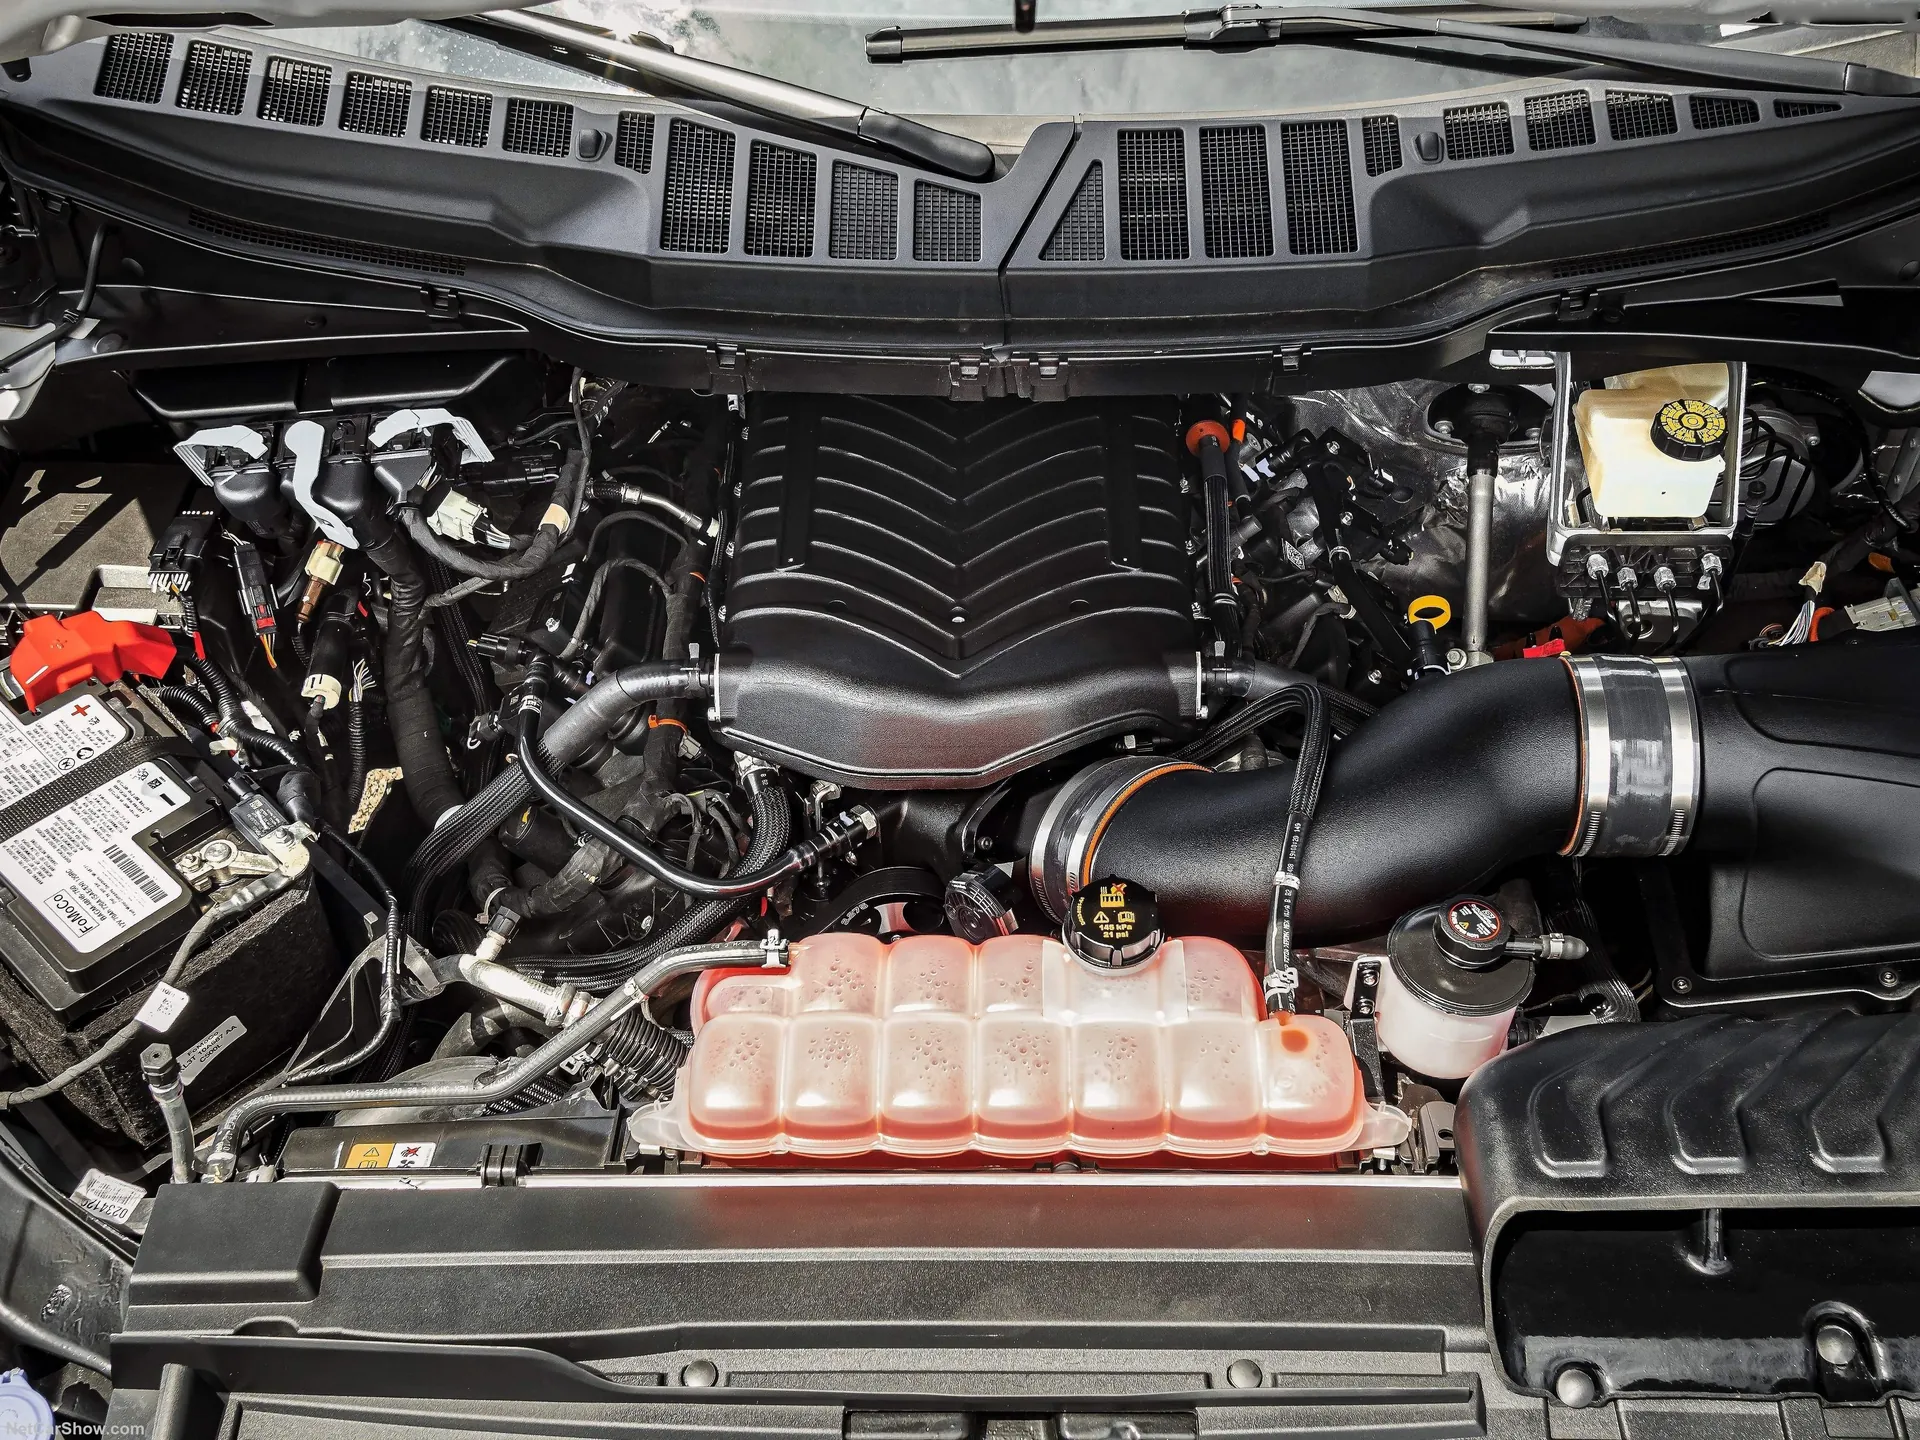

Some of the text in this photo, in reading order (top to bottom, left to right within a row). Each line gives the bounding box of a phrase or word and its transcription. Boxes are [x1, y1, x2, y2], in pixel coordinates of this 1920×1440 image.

[53, 894, 94, 933] FoMoCo
[1116, 931, 1129, 939] psi
[225, 1025, 238, 1035] AA
